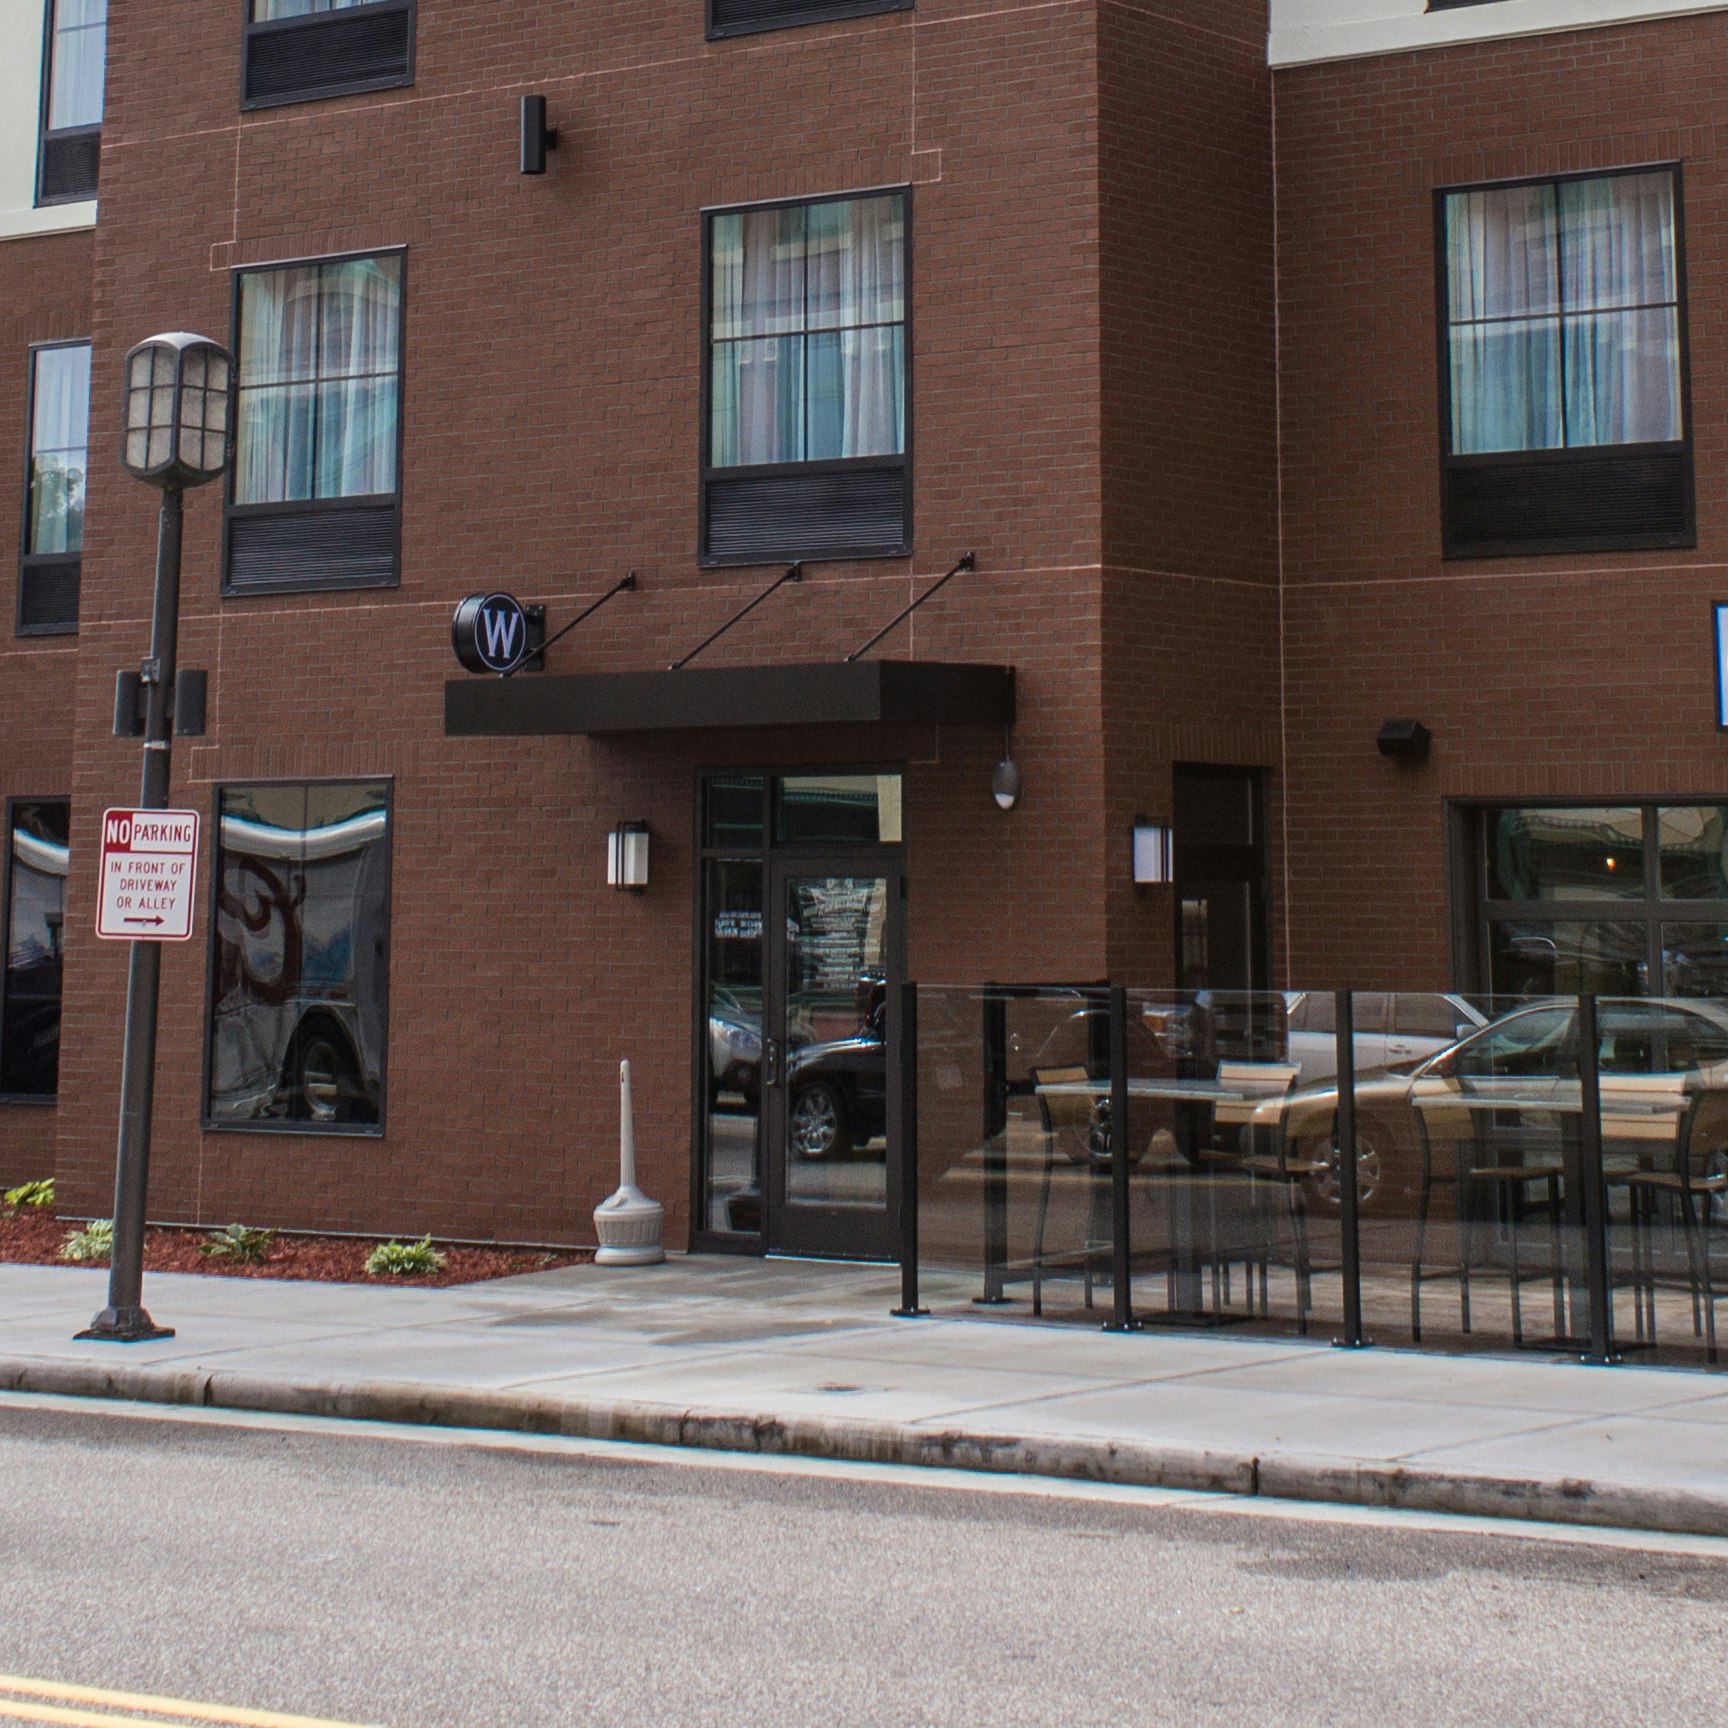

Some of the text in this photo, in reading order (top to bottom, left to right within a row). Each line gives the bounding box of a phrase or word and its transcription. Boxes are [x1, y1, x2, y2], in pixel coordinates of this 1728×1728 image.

[483, 608, 519, 659] W
[106, 819, 191, 845] NO PARKING
[110, 861, 186, 875] IN FRONT OF
[119, 878, 177, 892] DRIVEWAY
[116, 896, 176, 910] OR ALLEY
